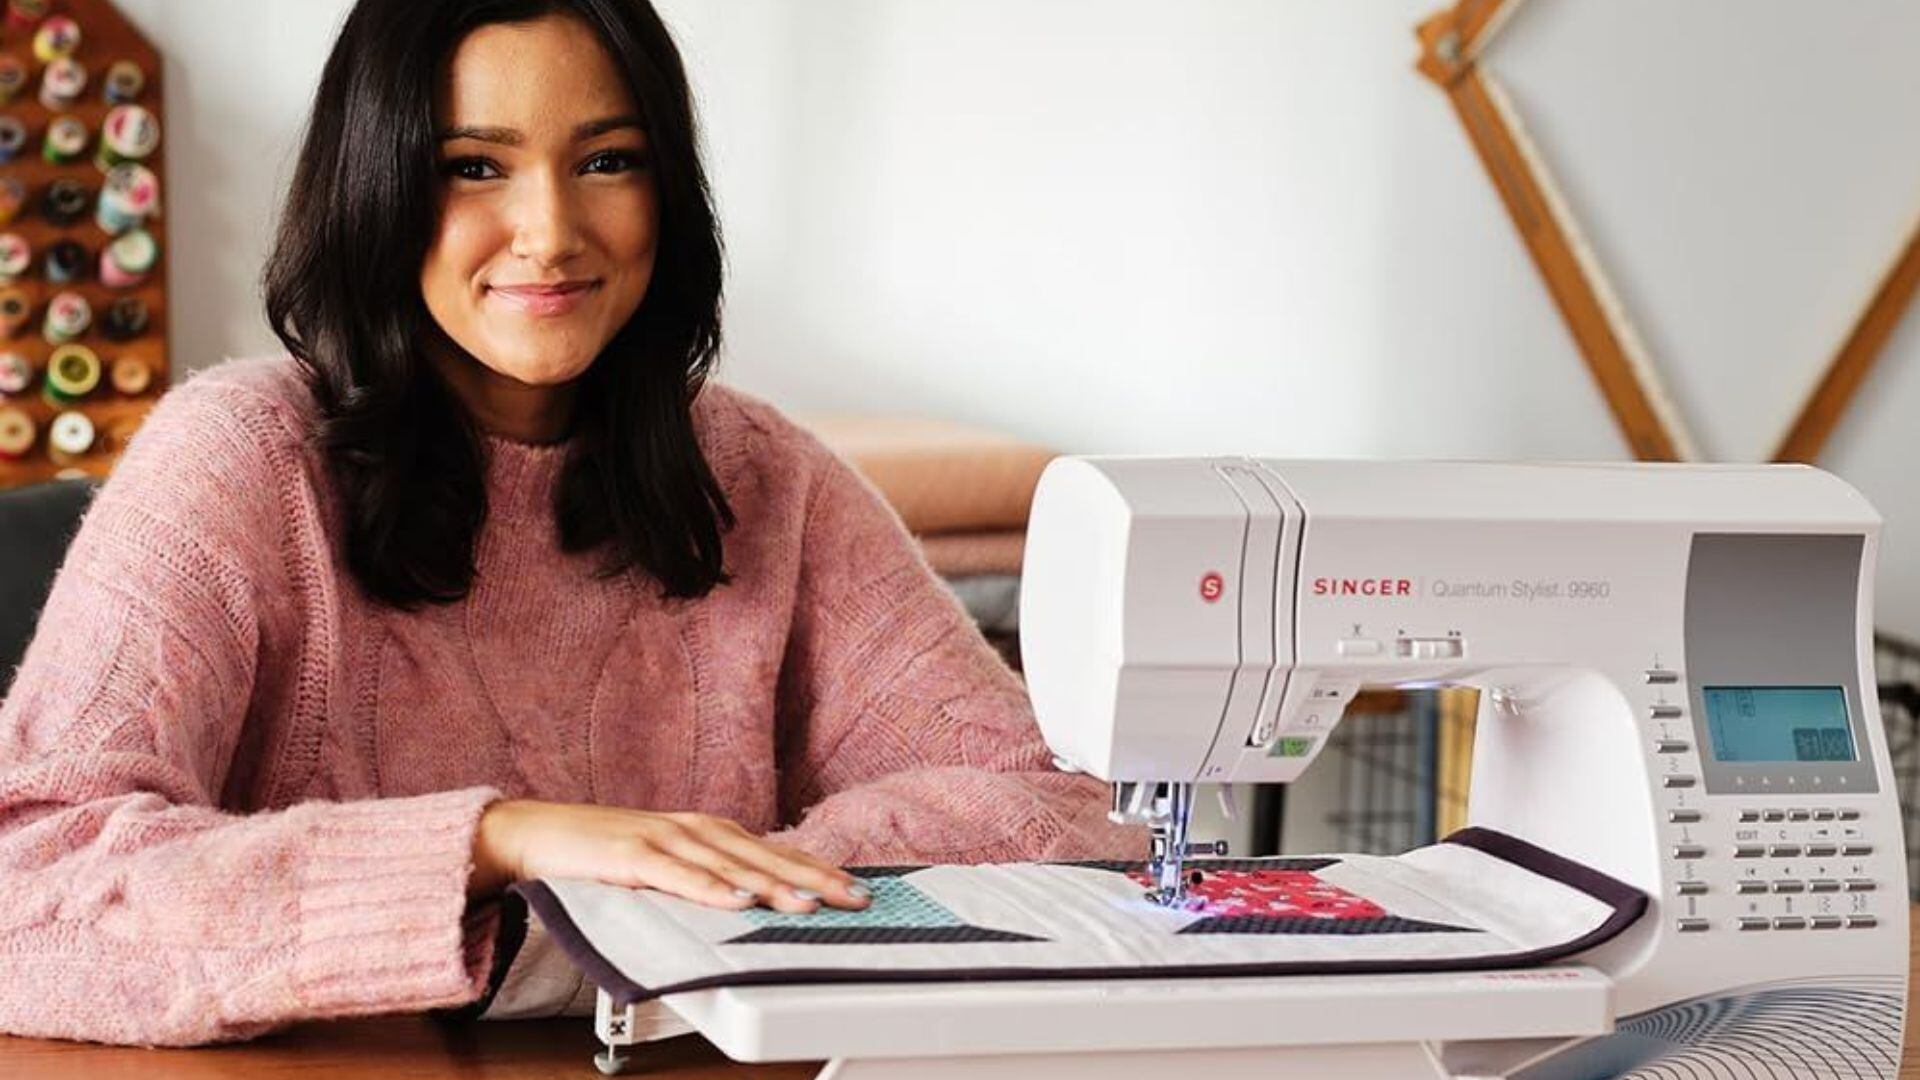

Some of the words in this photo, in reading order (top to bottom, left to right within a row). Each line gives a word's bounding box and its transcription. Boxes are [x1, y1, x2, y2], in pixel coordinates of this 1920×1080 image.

[1203, 576, 1221, 598] S
[1314, 578, 1411, 596] SINGER
[1432, 579, 1507, 598] Quantum
[1568, 580, 1611, 599] 9960
